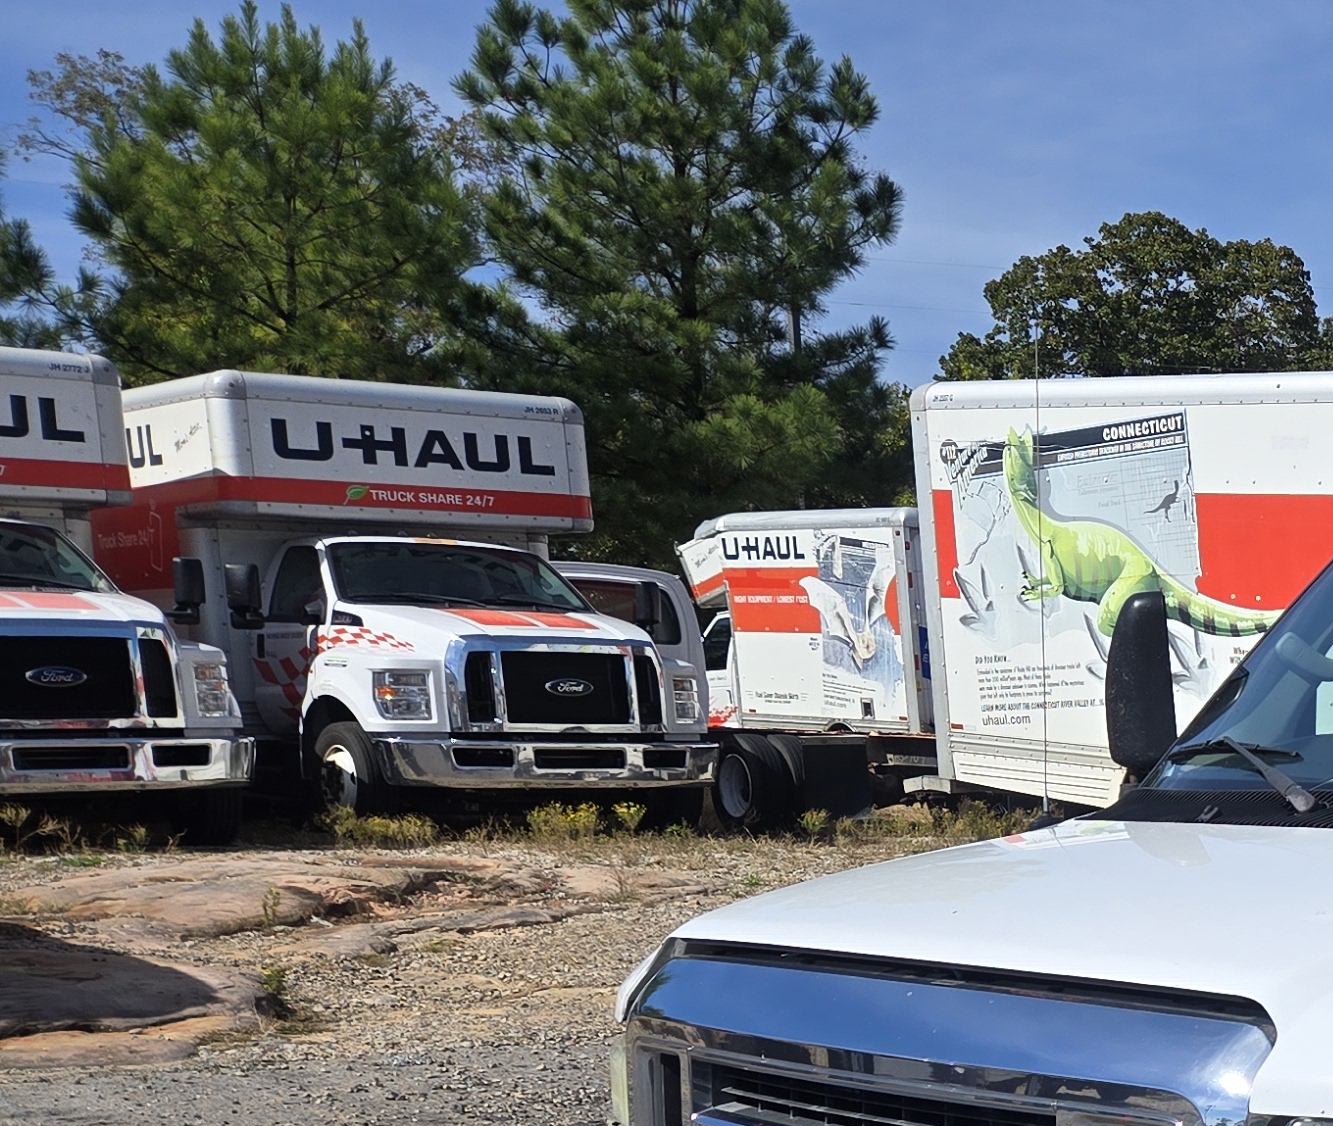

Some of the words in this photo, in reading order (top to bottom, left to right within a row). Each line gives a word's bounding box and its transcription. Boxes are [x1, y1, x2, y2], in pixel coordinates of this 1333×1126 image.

[1102, 415, 1183, 441] CONNECTICUT
[270, 418, 556, 476] U-HAUL
[369, 489, 415, 503] TRUCK
[418, 491, 463, 506] SHARE
[466, 493, 494, 507] 24/7
[721, 536, 806, 560] U-HAUL
[40, 669, 74, 682] Ford
[557, 681, 584, 692] Ford
[982, 714, 1031, 726] uhaul.com
